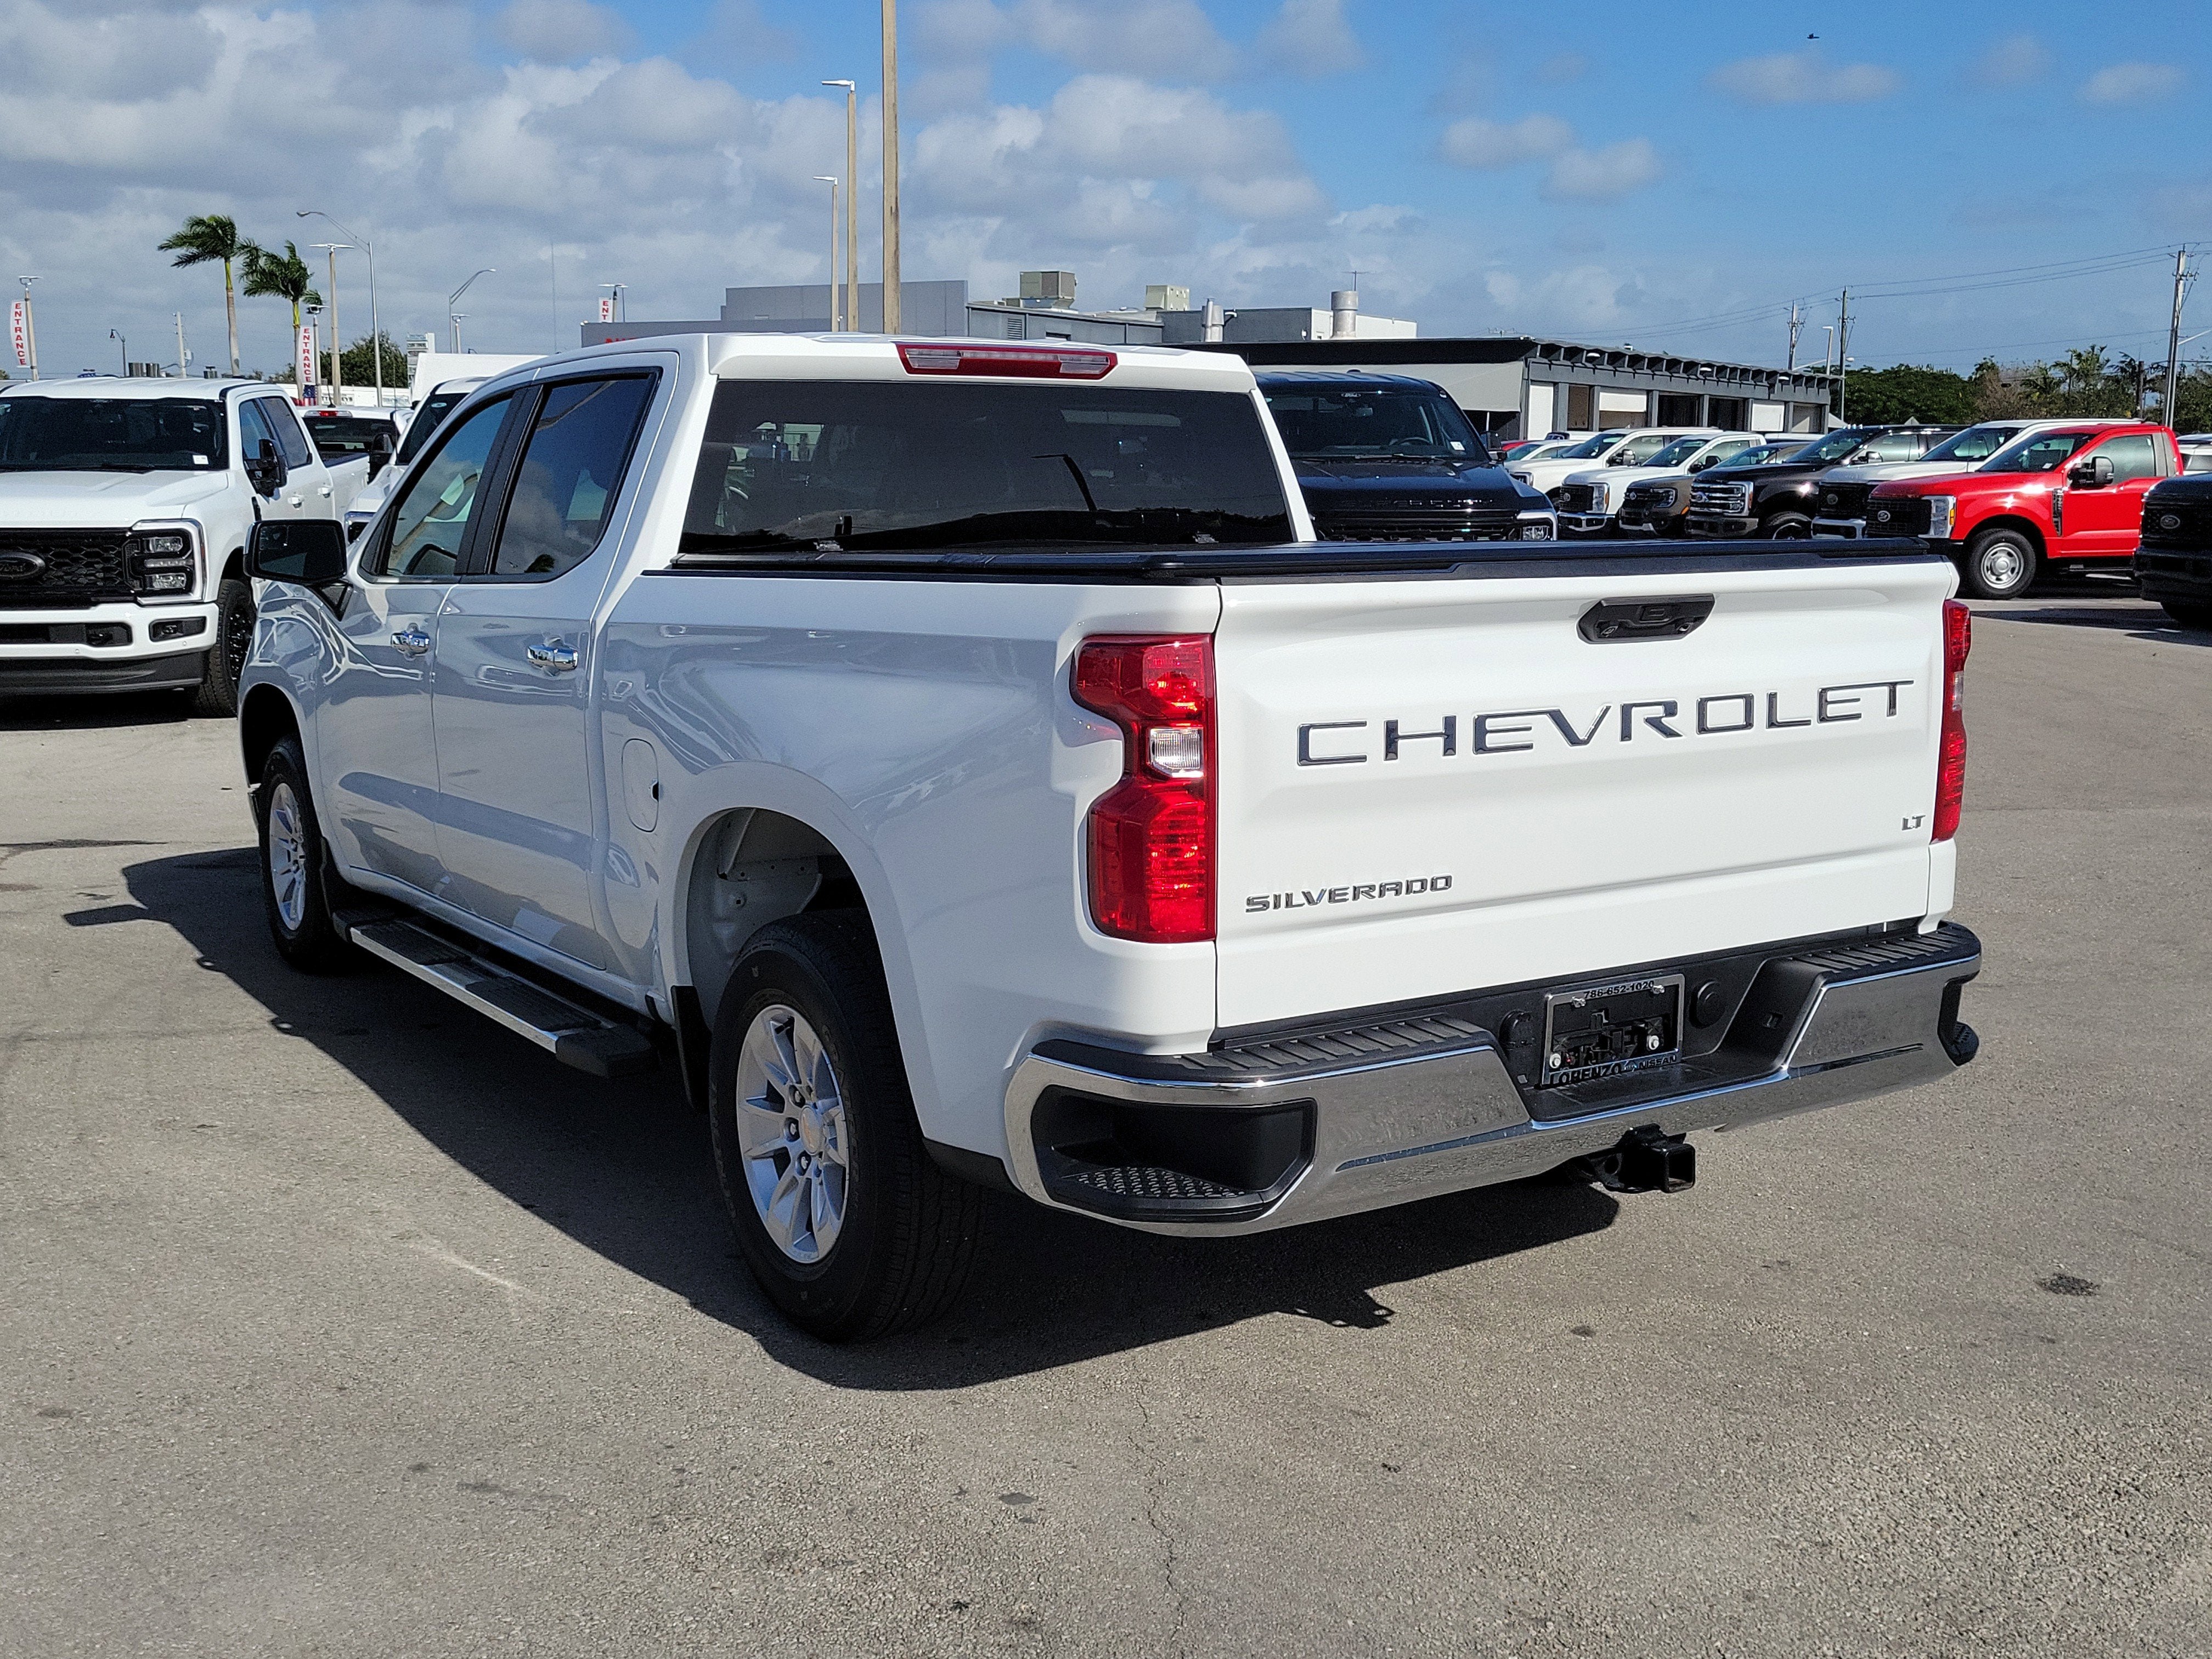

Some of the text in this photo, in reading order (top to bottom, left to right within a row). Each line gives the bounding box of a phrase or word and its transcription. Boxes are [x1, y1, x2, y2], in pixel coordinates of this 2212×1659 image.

[14, 303, 26, 365] ENTRANCE
[303, 328, 312, 382] ENTRANCE
[1296, 680, 1914, 766] CHEVROLET
[1901, 815, 1926, 831] LT
[1245, 875, 1452, 913] SILVERADO
[1584, 980, 1655, 1000] 786-652-1020
[1549, 1055, 1677, 1085] LORENZO NISSAN
